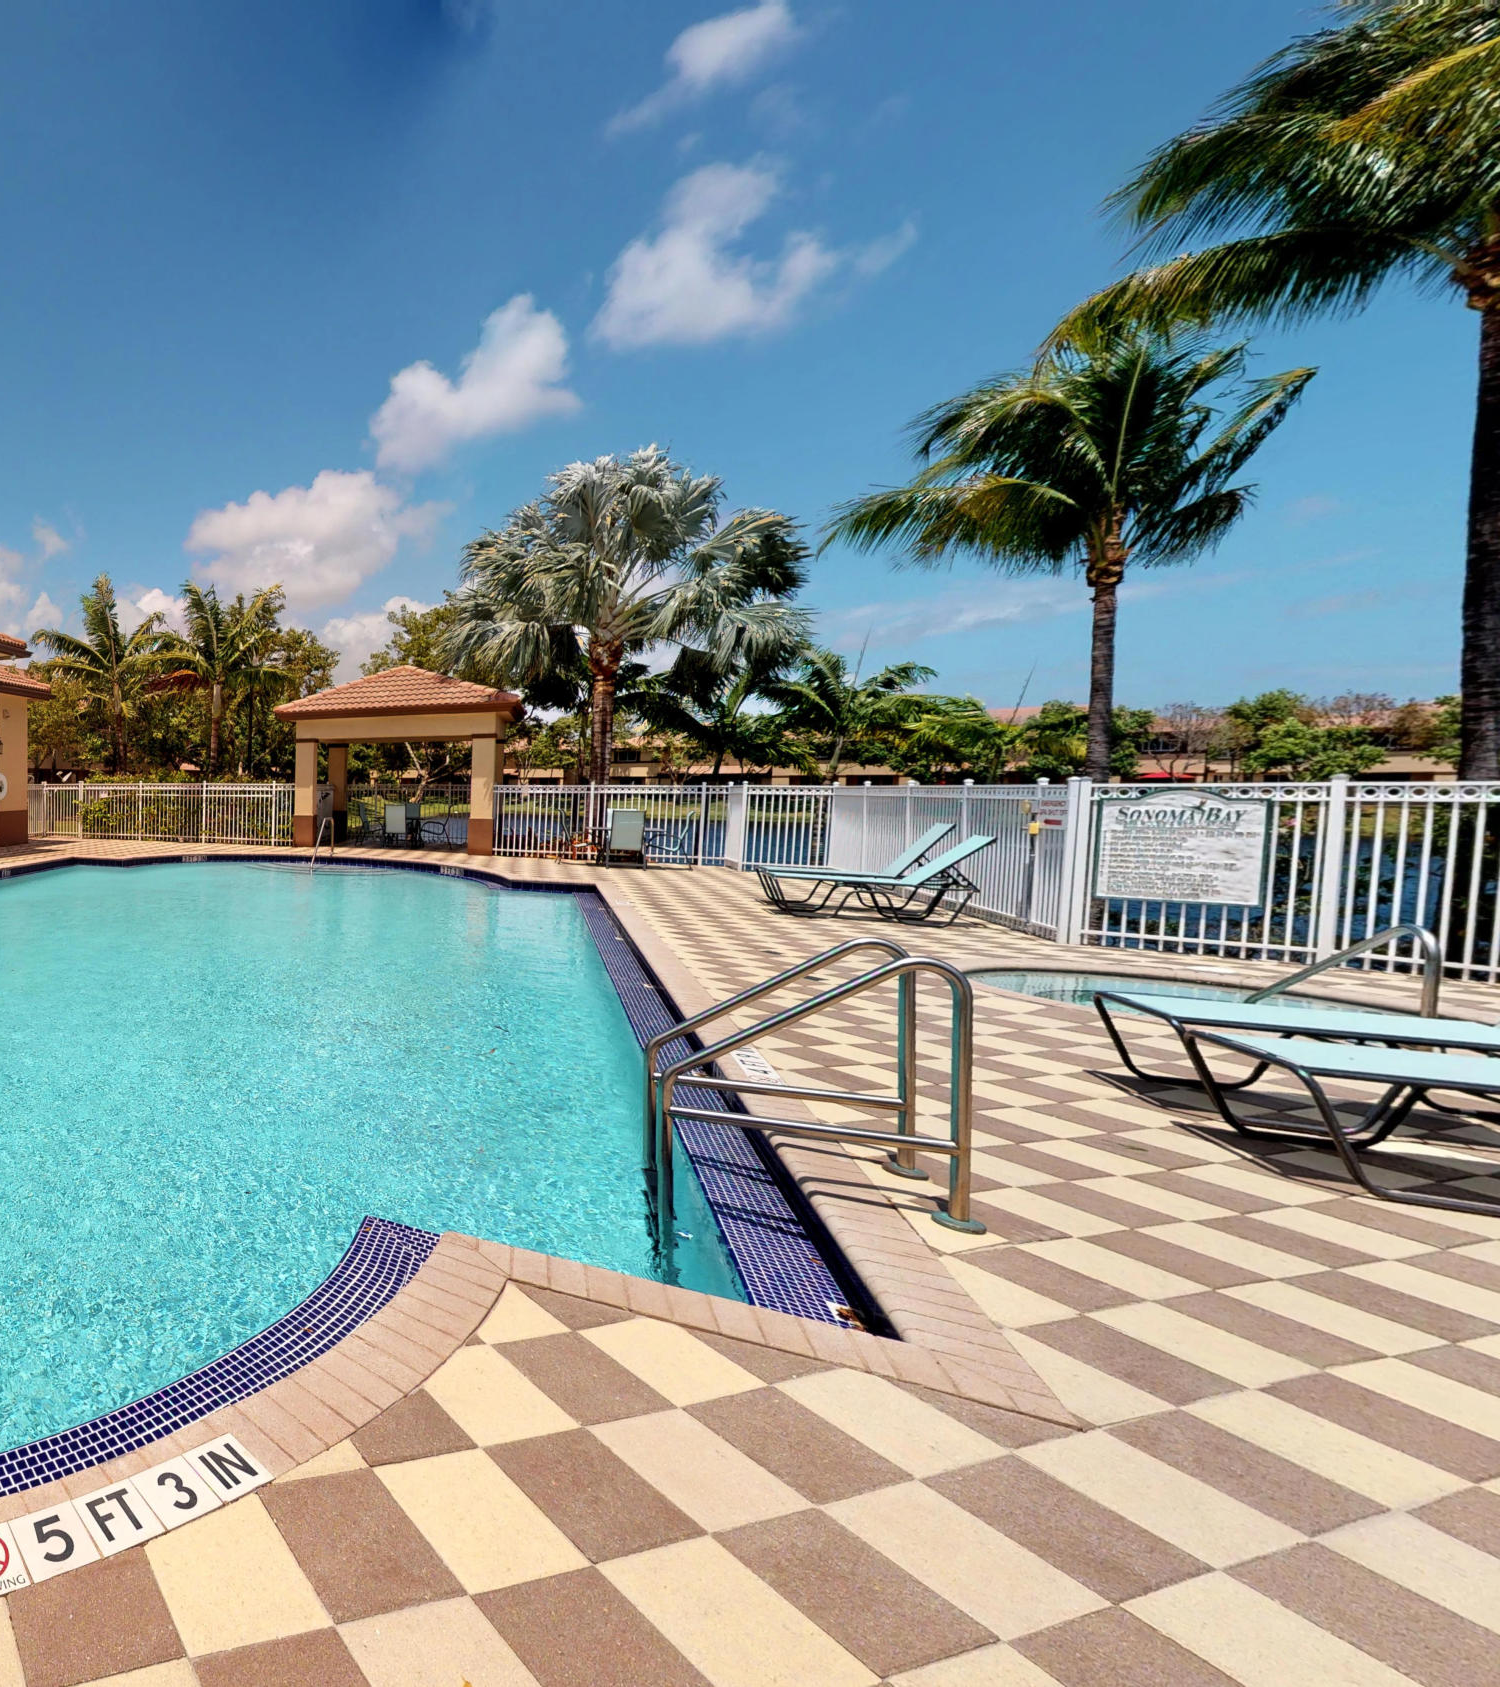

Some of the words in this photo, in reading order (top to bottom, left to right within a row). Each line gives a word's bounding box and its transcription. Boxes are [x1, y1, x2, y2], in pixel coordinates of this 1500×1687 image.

[1117, 806, 1196, 823] SONOMA
[1206, 807, 1247, 823] BAY
[34, 1514, 74, 1562] 5
[85, 1488, 143, 1542] FT
[157, 1472, 198, 1510] 3
[198, 1442, 258, 1490] IN
